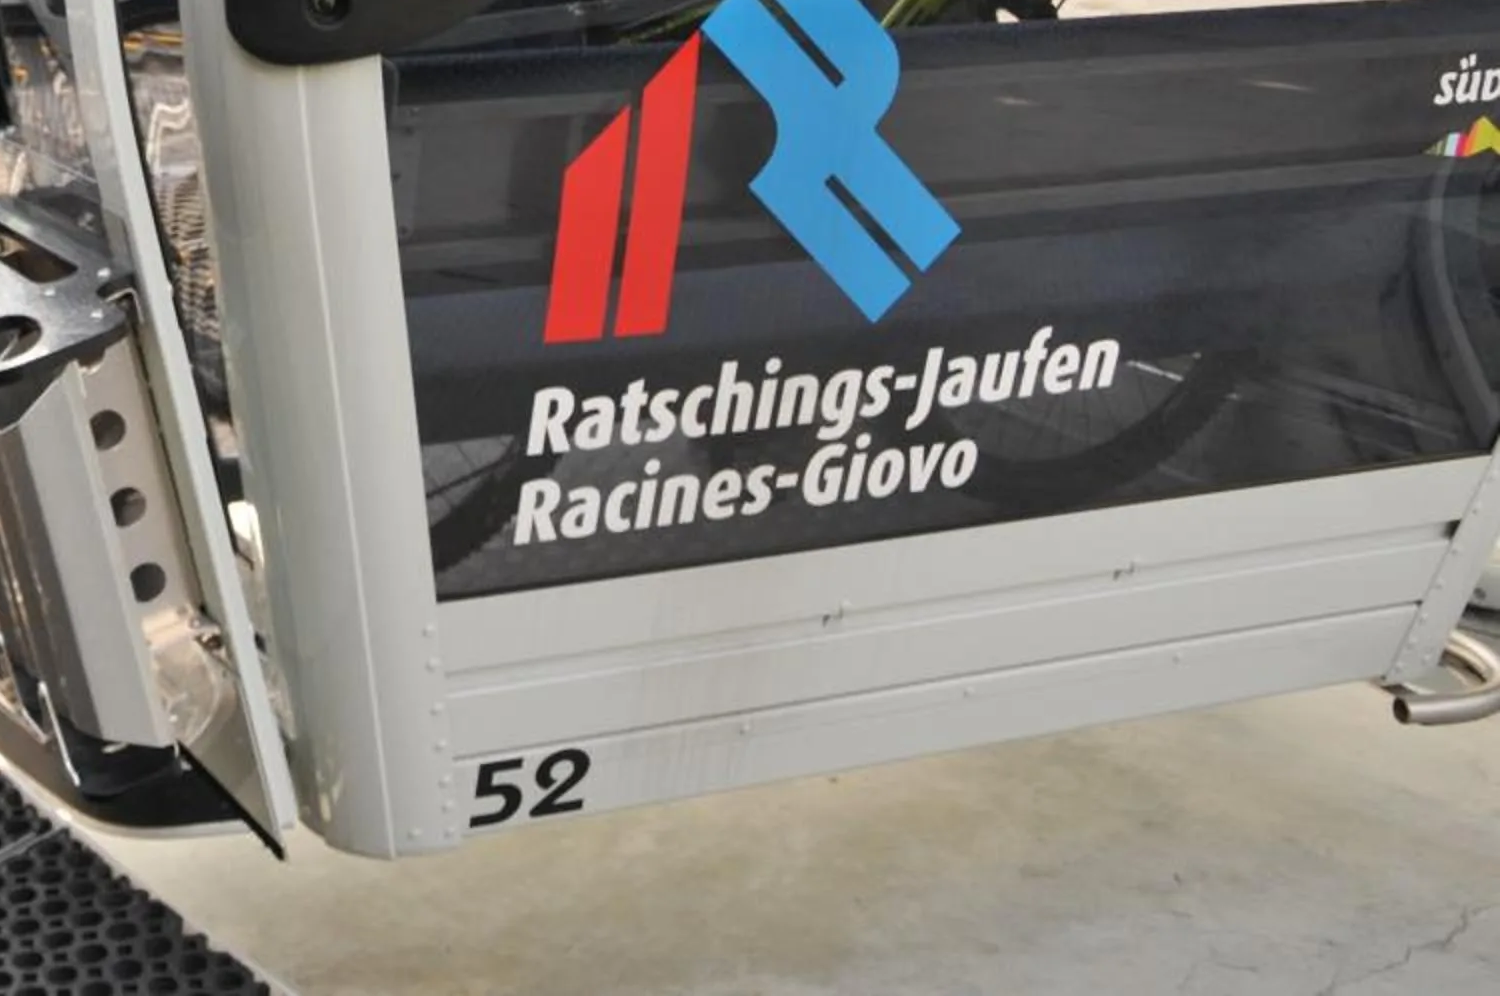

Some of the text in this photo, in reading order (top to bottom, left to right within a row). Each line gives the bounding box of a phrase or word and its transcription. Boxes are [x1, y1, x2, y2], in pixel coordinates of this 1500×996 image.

[525, 325, 1121, 456] Ratschings-Jaufen
[512, 438, 979, 546] Racines-Giovo
[469, 748, 591, 828] 52
